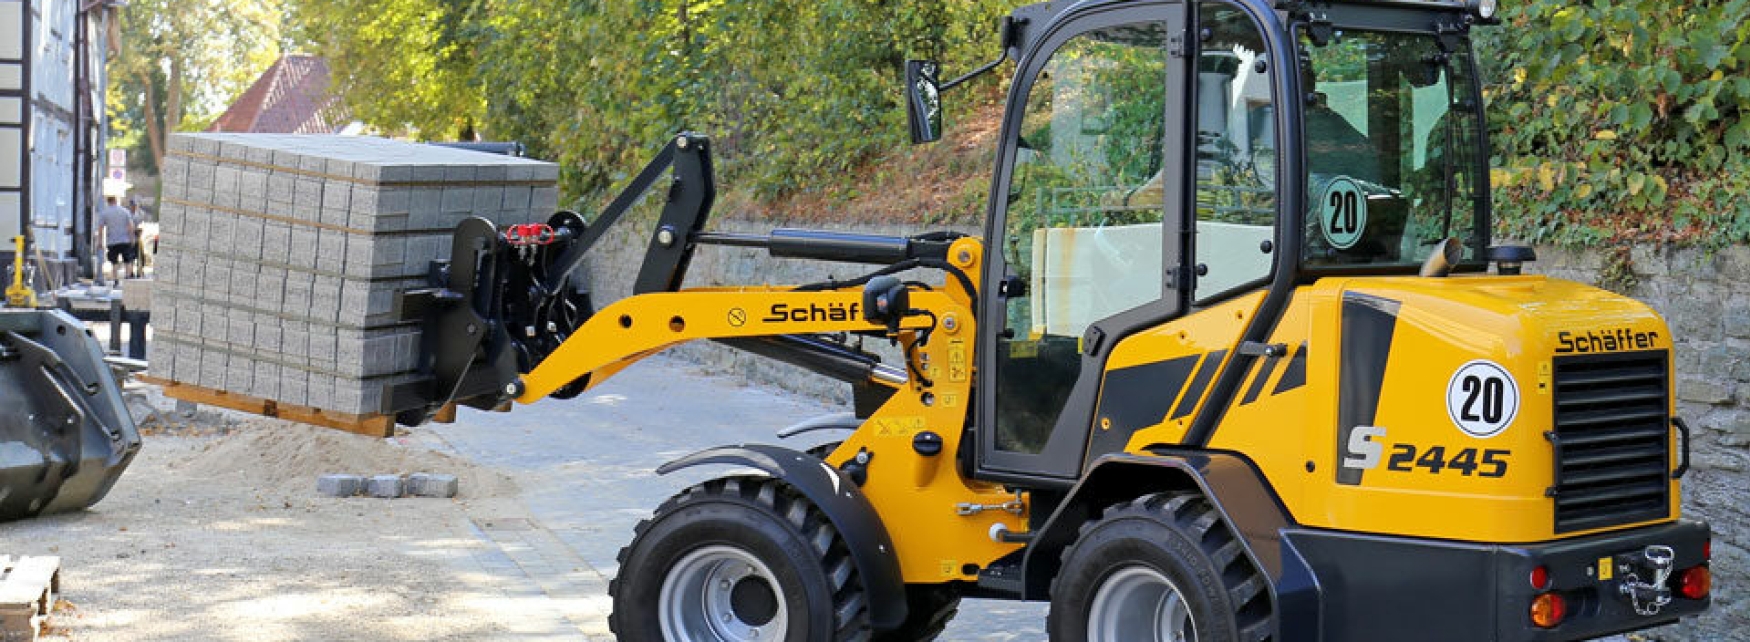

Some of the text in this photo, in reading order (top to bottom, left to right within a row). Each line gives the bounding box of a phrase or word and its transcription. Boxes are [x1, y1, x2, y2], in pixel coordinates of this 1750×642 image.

[1329, 190, 1358, 234] 20
[762, 302, 863, 322] Schäf
[1555, 328, 1658, 353] Schäffer
[1460, 375, 1504, 424] 20
[1343, 425, 1511, 478] S 2445
